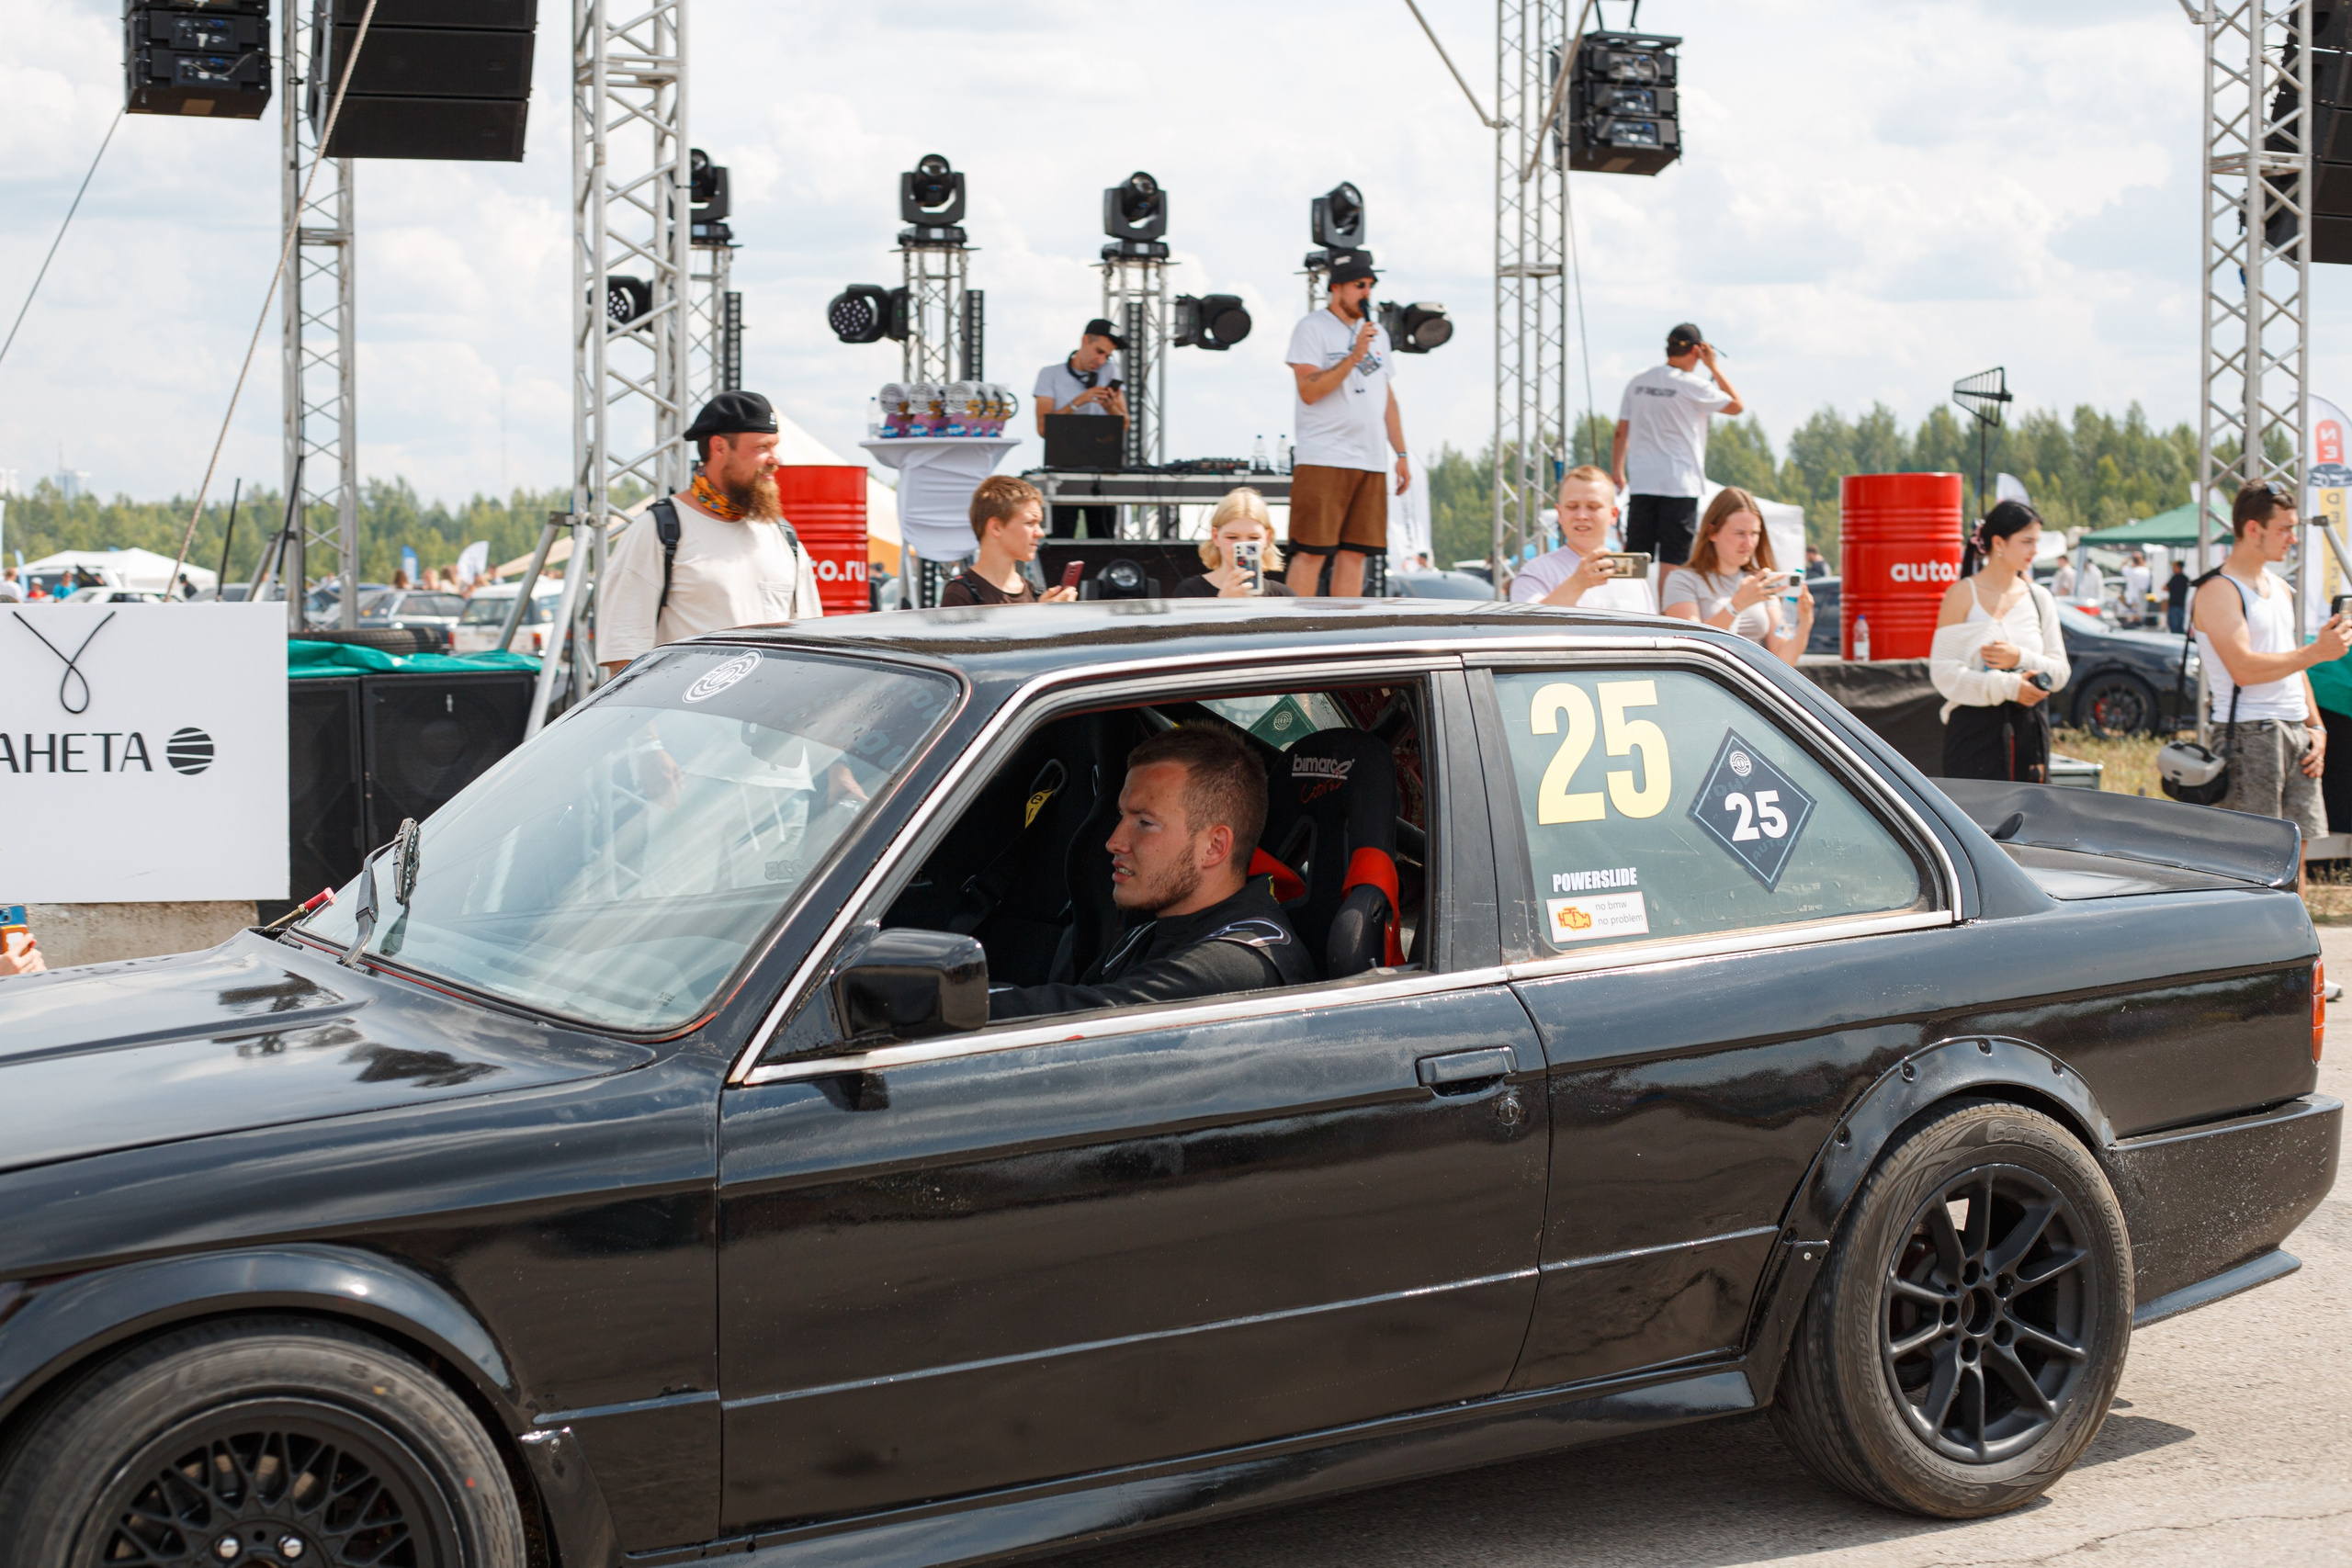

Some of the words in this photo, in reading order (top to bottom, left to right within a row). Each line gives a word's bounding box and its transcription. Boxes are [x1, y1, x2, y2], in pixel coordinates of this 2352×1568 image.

[0, 732, 153, 773] АНЕТА
[1530, 679, 1672, 826] 25
[1724, 789, 1789, 842] 25
[1552, 867, 1638, 893] POWERSLIDE
[1595, 903, 1606, 911] no
[1607, 900, 1627, 910] bmw
[1598, 918, 1609, 926] no
[1611, 913, 1644, 928] problem
